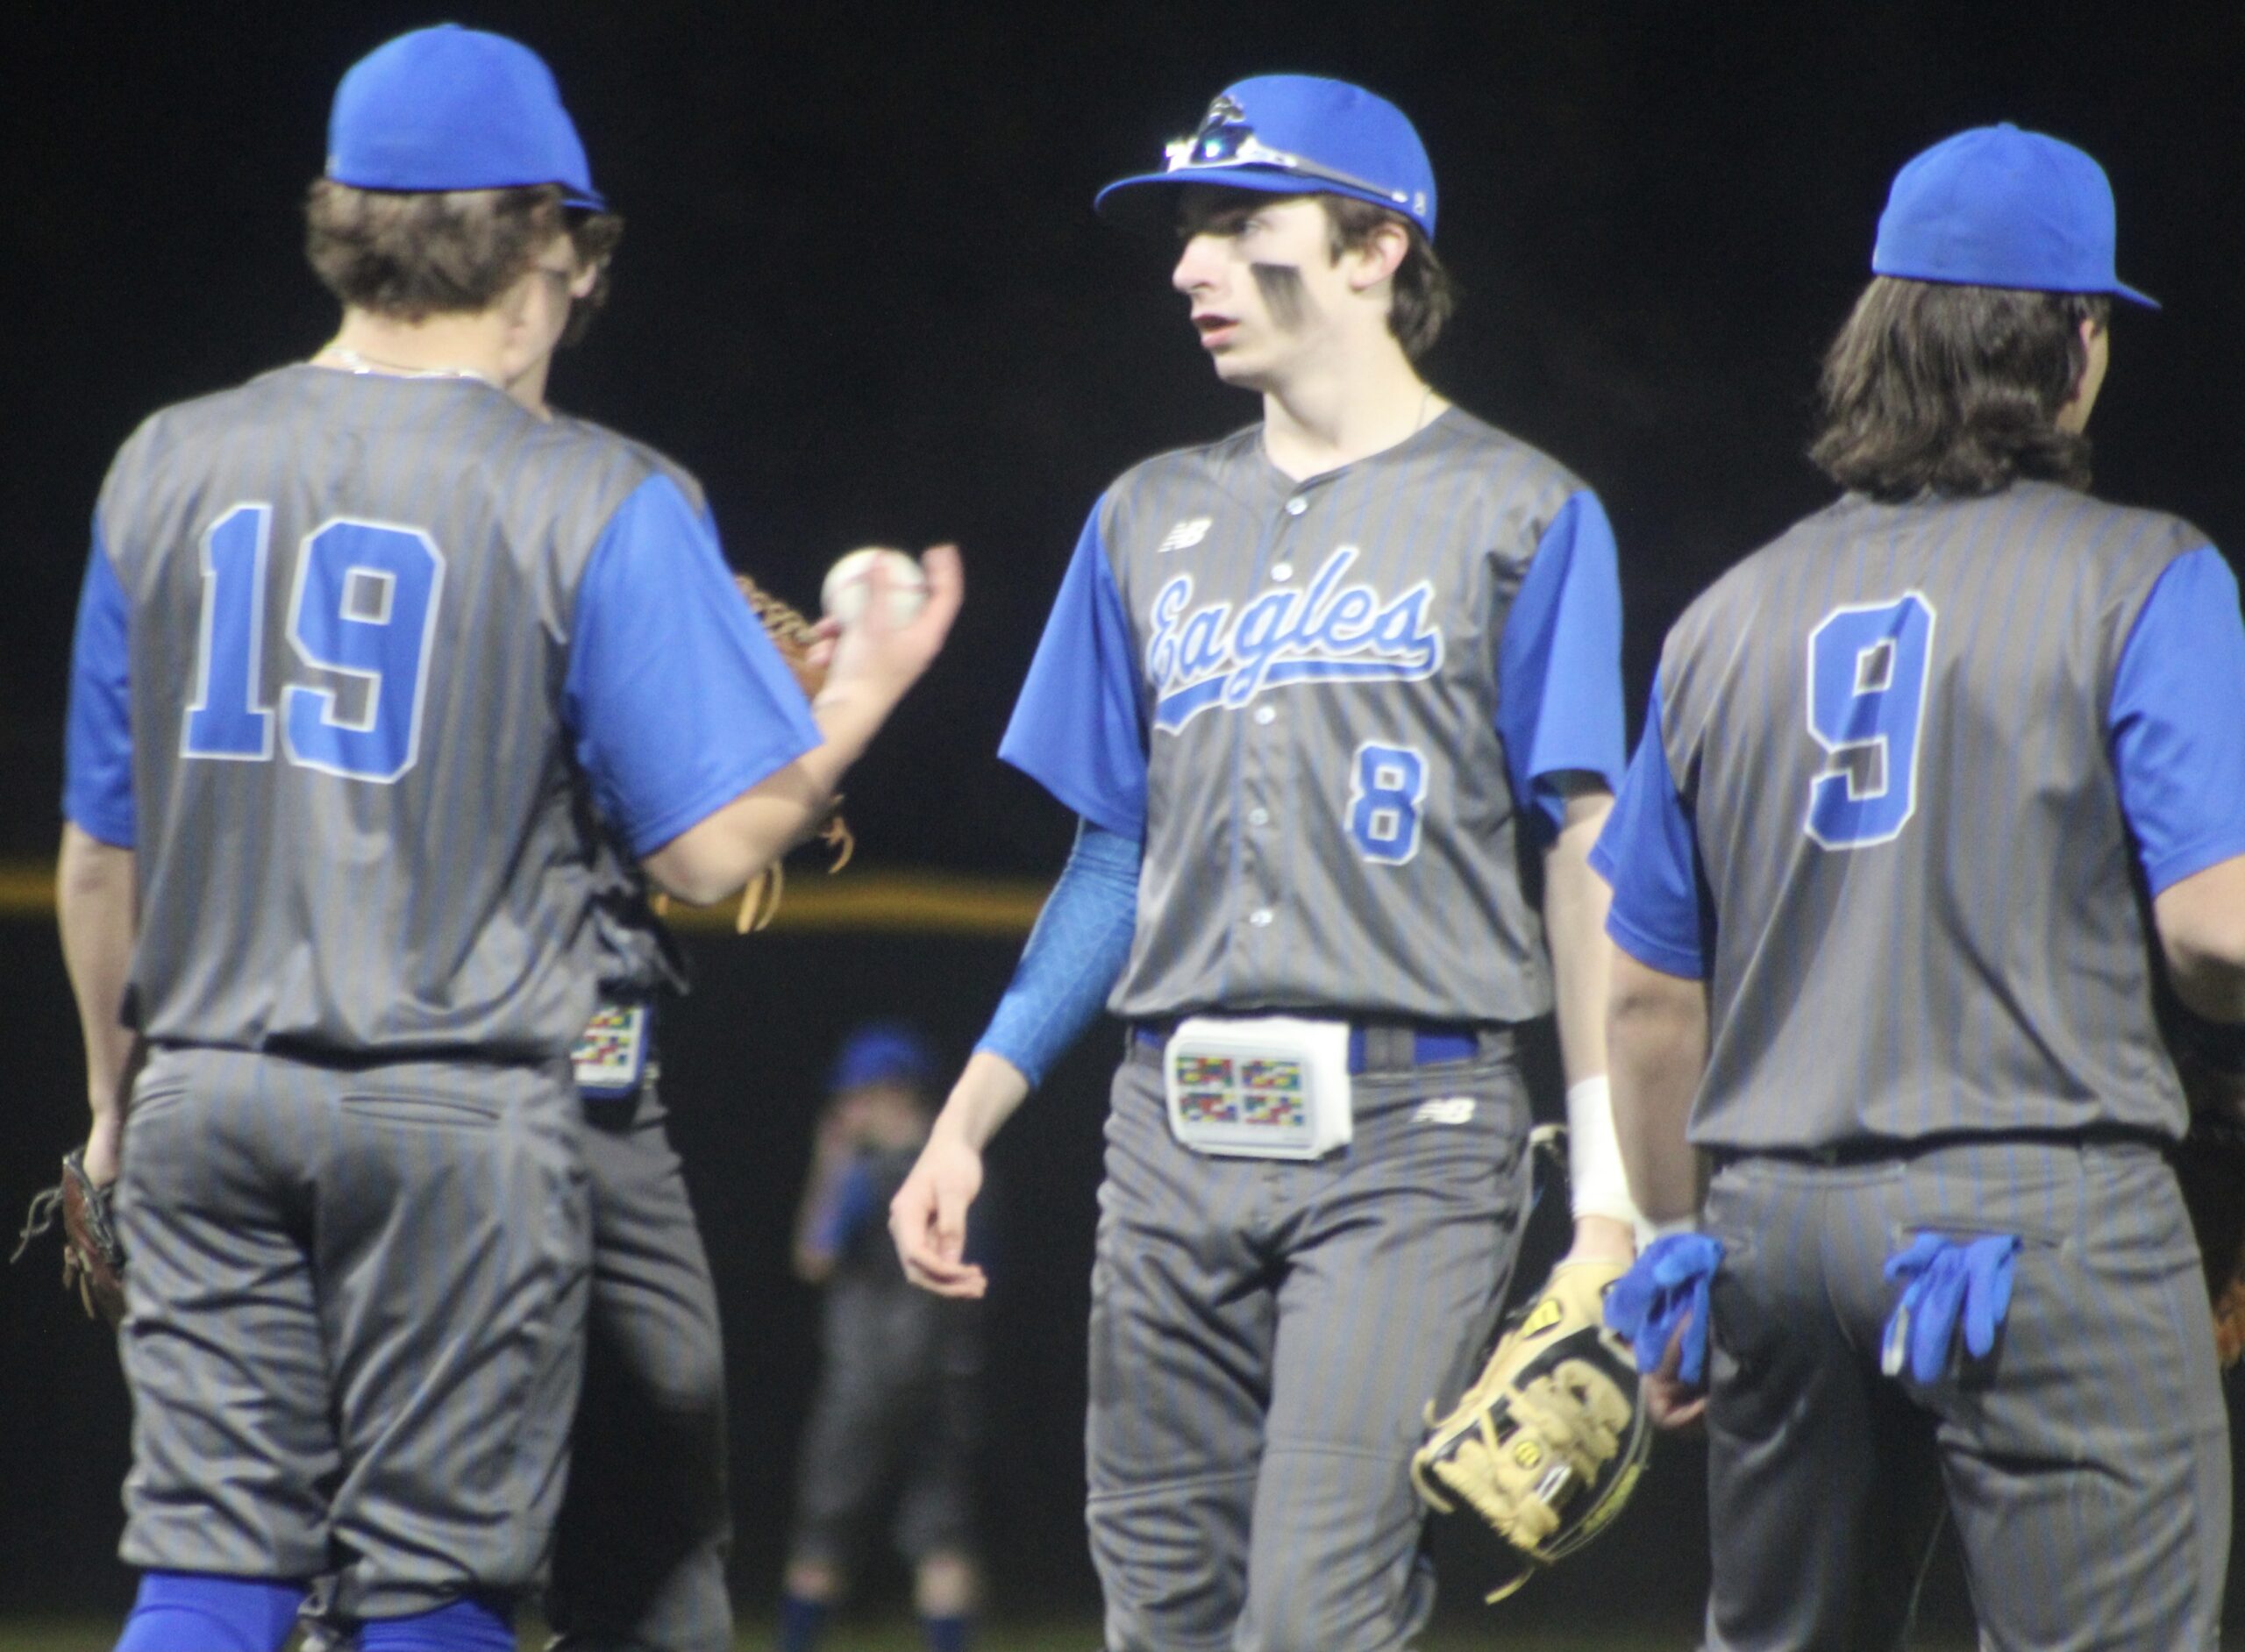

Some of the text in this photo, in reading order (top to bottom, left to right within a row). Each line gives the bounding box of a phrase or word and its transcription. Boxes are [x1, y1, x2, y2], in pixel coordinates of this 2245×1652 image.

[180, 502, 446, 785] 19
[1145, 545, 1445, 710] Eagles
[1803, 589, 1937, 851] 9
[1343, 740, 1429, 865] 8
